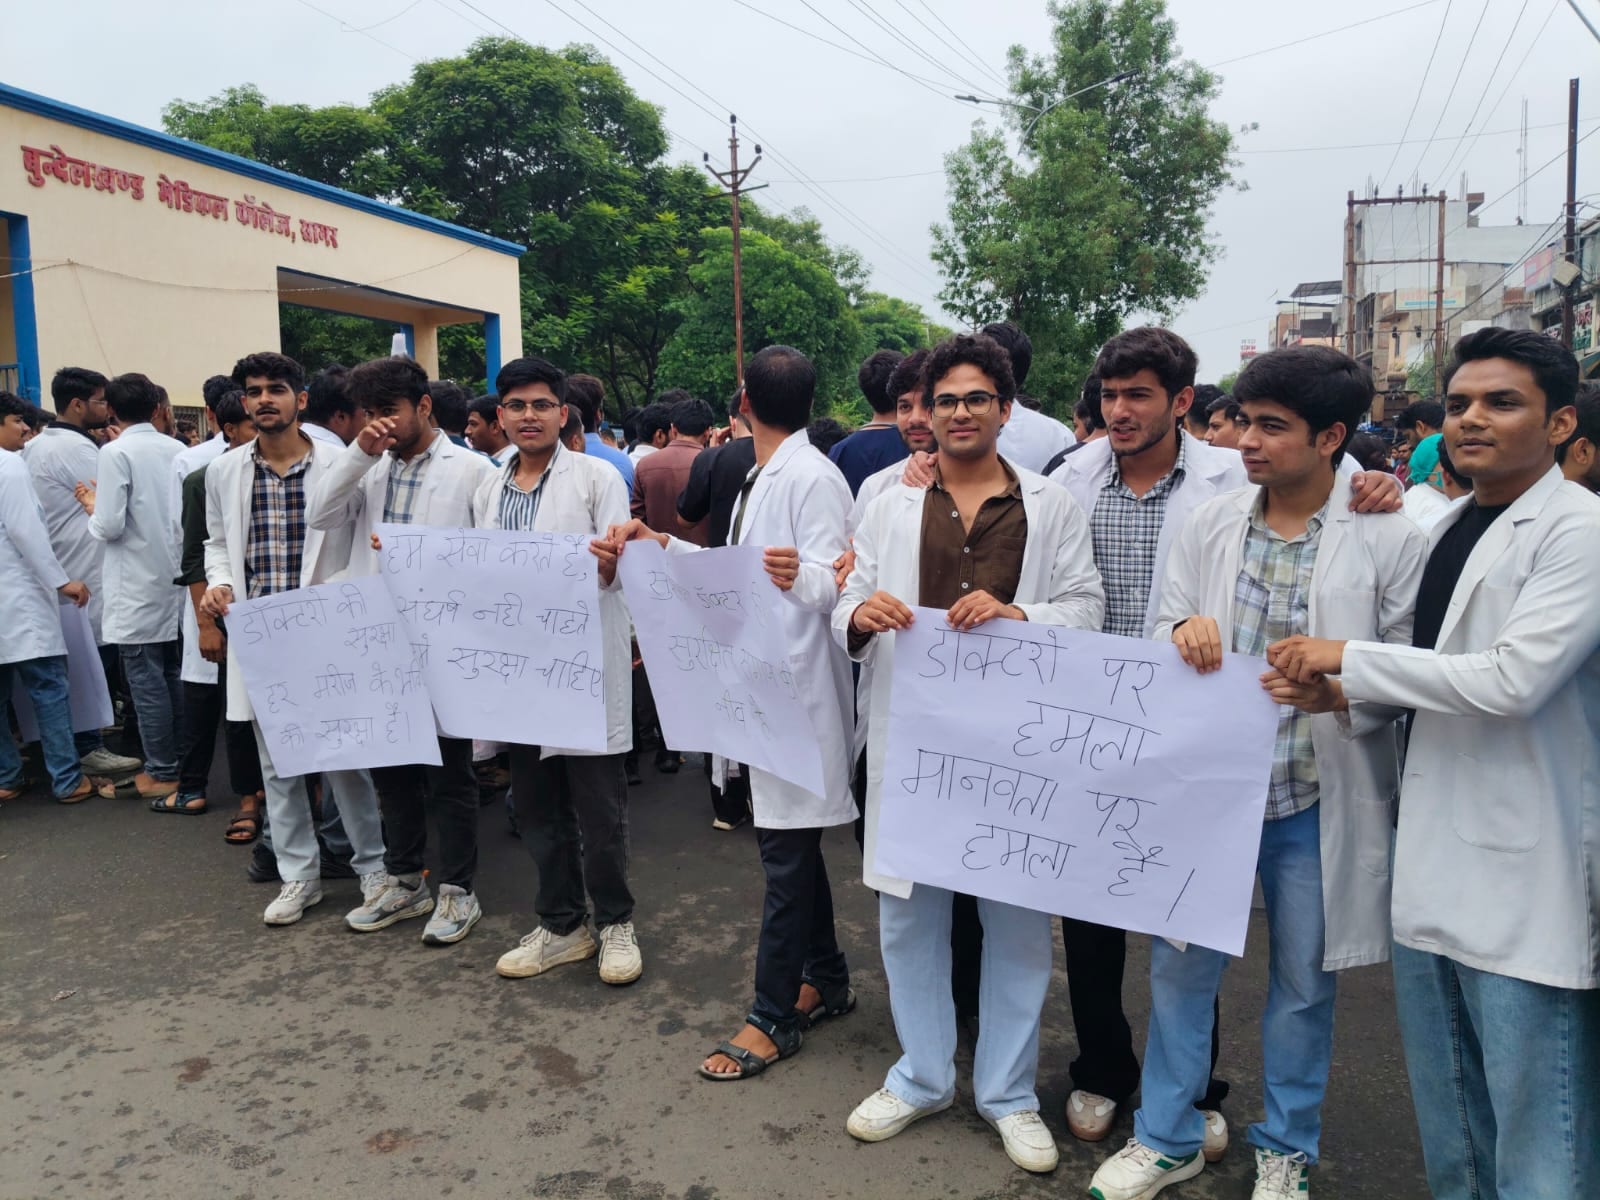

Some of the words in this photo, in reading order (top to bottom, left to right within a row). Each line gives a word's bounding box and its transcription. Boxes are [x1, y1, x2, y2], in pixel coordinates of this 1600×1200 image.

[157, 173, 229, 222] मेडिकल
[299, 218, 338, 249] सागर
[387, 534, 427, 575] हम
[437, 527, 490, 568] सेवा
[500, 533, 561, 574] करते
[336, 583, 368, 619] की
[535, 600, 592, 635] चाहते
[265, 681, 299, 714] हर
[313, 663, 358, 699] मरीज
[369, 661, 394, 696] के
[447, 647, 529, 685] सुरक्षा
[1103, 658, 1161, 717] पर
[280, 723, 305, 751] की
[315, 716, 374, 751] सुरक्षा
[1013, 700, 1162, 771] हमला
[901, 748, 1059, 822] मानवता
[1086, 790, 1158, 849] पर
[961, 823, 1077, 880] हमला
